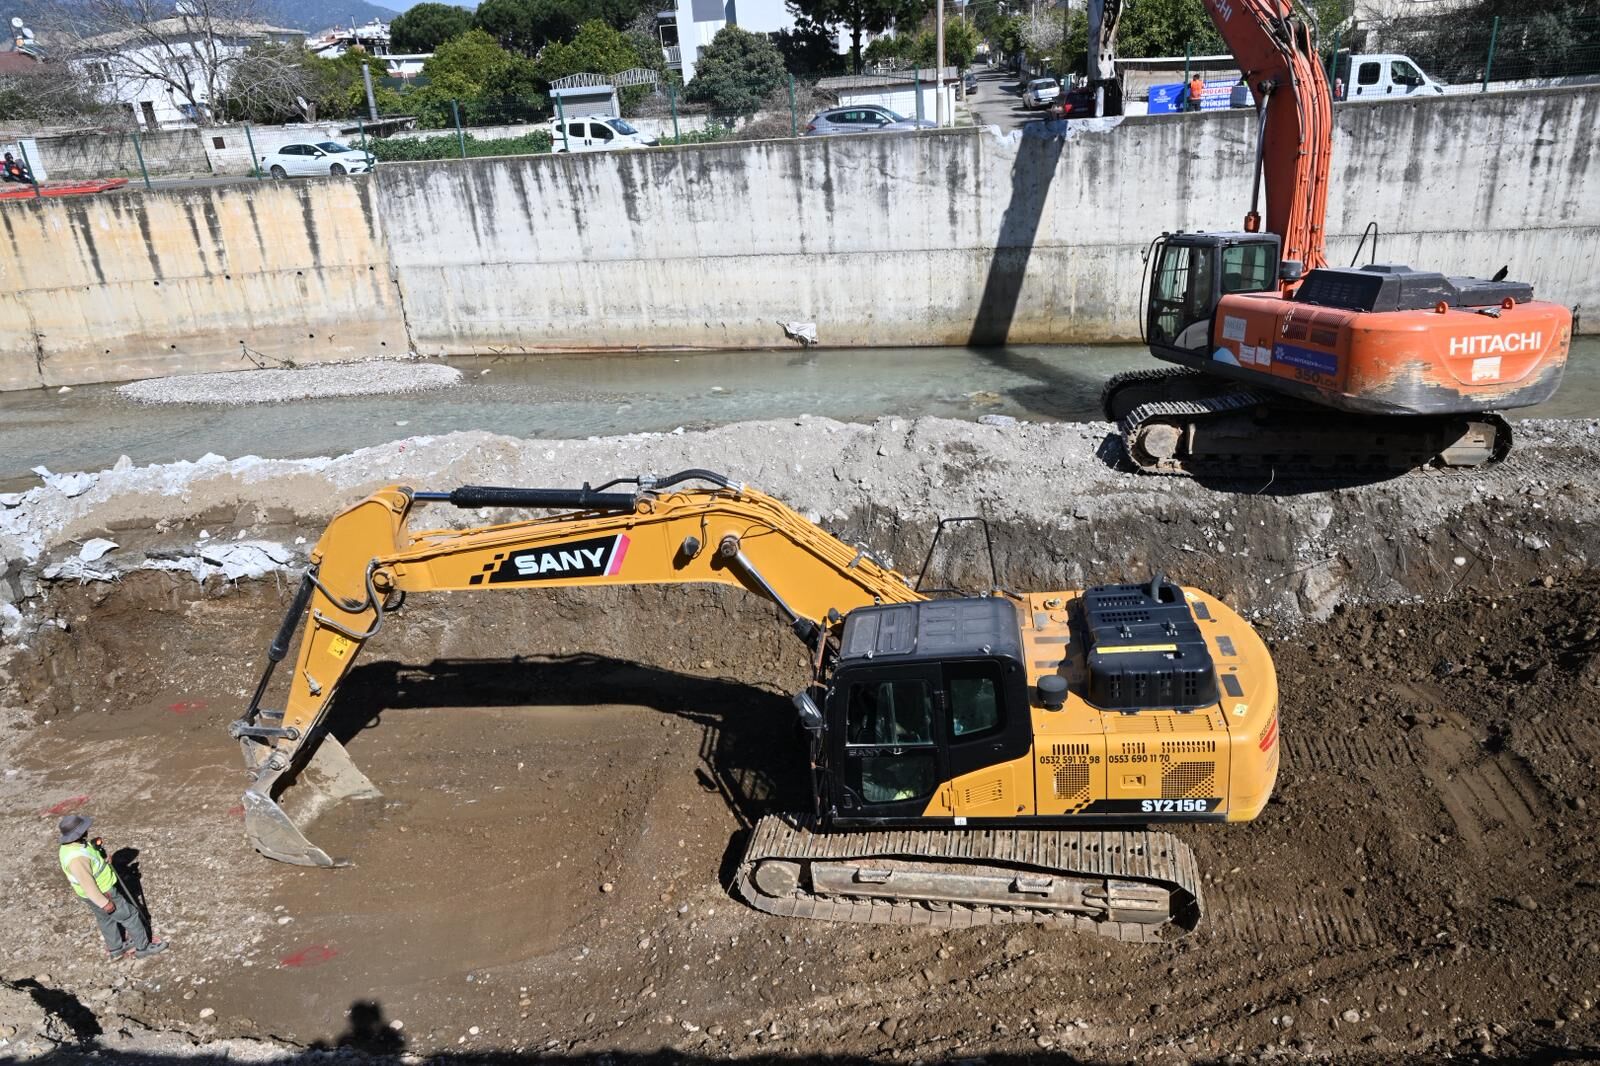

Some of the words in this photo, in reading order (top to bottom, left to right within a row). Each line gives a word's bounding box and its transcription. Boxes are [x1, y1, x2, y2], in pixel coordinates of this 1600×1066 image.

[1449, 331, 1542, 356] HITACHI
[514, 547, 605, 576] SANY
[1040, 755, 1061, 765] 0532
[1062, 755, 1077, 764] 591
[1078, 755, 1088, 764] 12
[1089, 755, 1101, 764] 98
[1108, 754, 1129, 764] 0553
[1131, 754, 1148, 763] 690
[1150, 754, 1157, 763] 11
[1159, 754, 1170, 763] 70
[1141, 798, 1207, 813] SY215C
